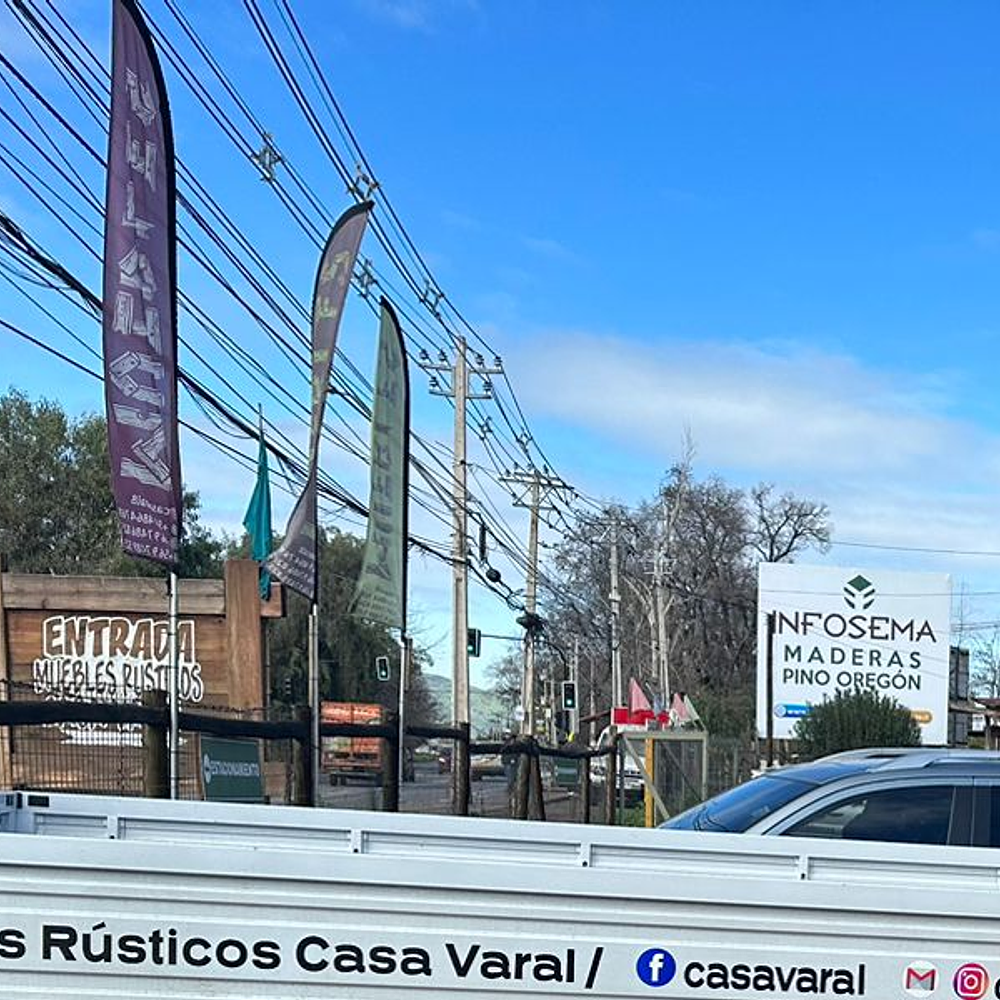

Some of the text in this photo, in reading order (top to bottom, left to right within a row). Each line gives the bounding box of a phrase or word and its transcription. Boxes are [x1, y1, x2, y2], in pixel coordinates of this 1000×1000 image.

[43, 615, 194, 664] ENTRADA
[772, 610, 937, 643] INFOSEMA
[784, 645, 921, 669] MADERAS
[33, 658, 205, 703] MUEBLES RUSTIOS
[783, 668, 922, 691] PINO OREGÓN
[42, 922, 281, 970] Rústicos
[296, 936, 432, 977] Casa
[445, 943, 575, 983] Varal
[683, 961, 866, 996] casavaral
